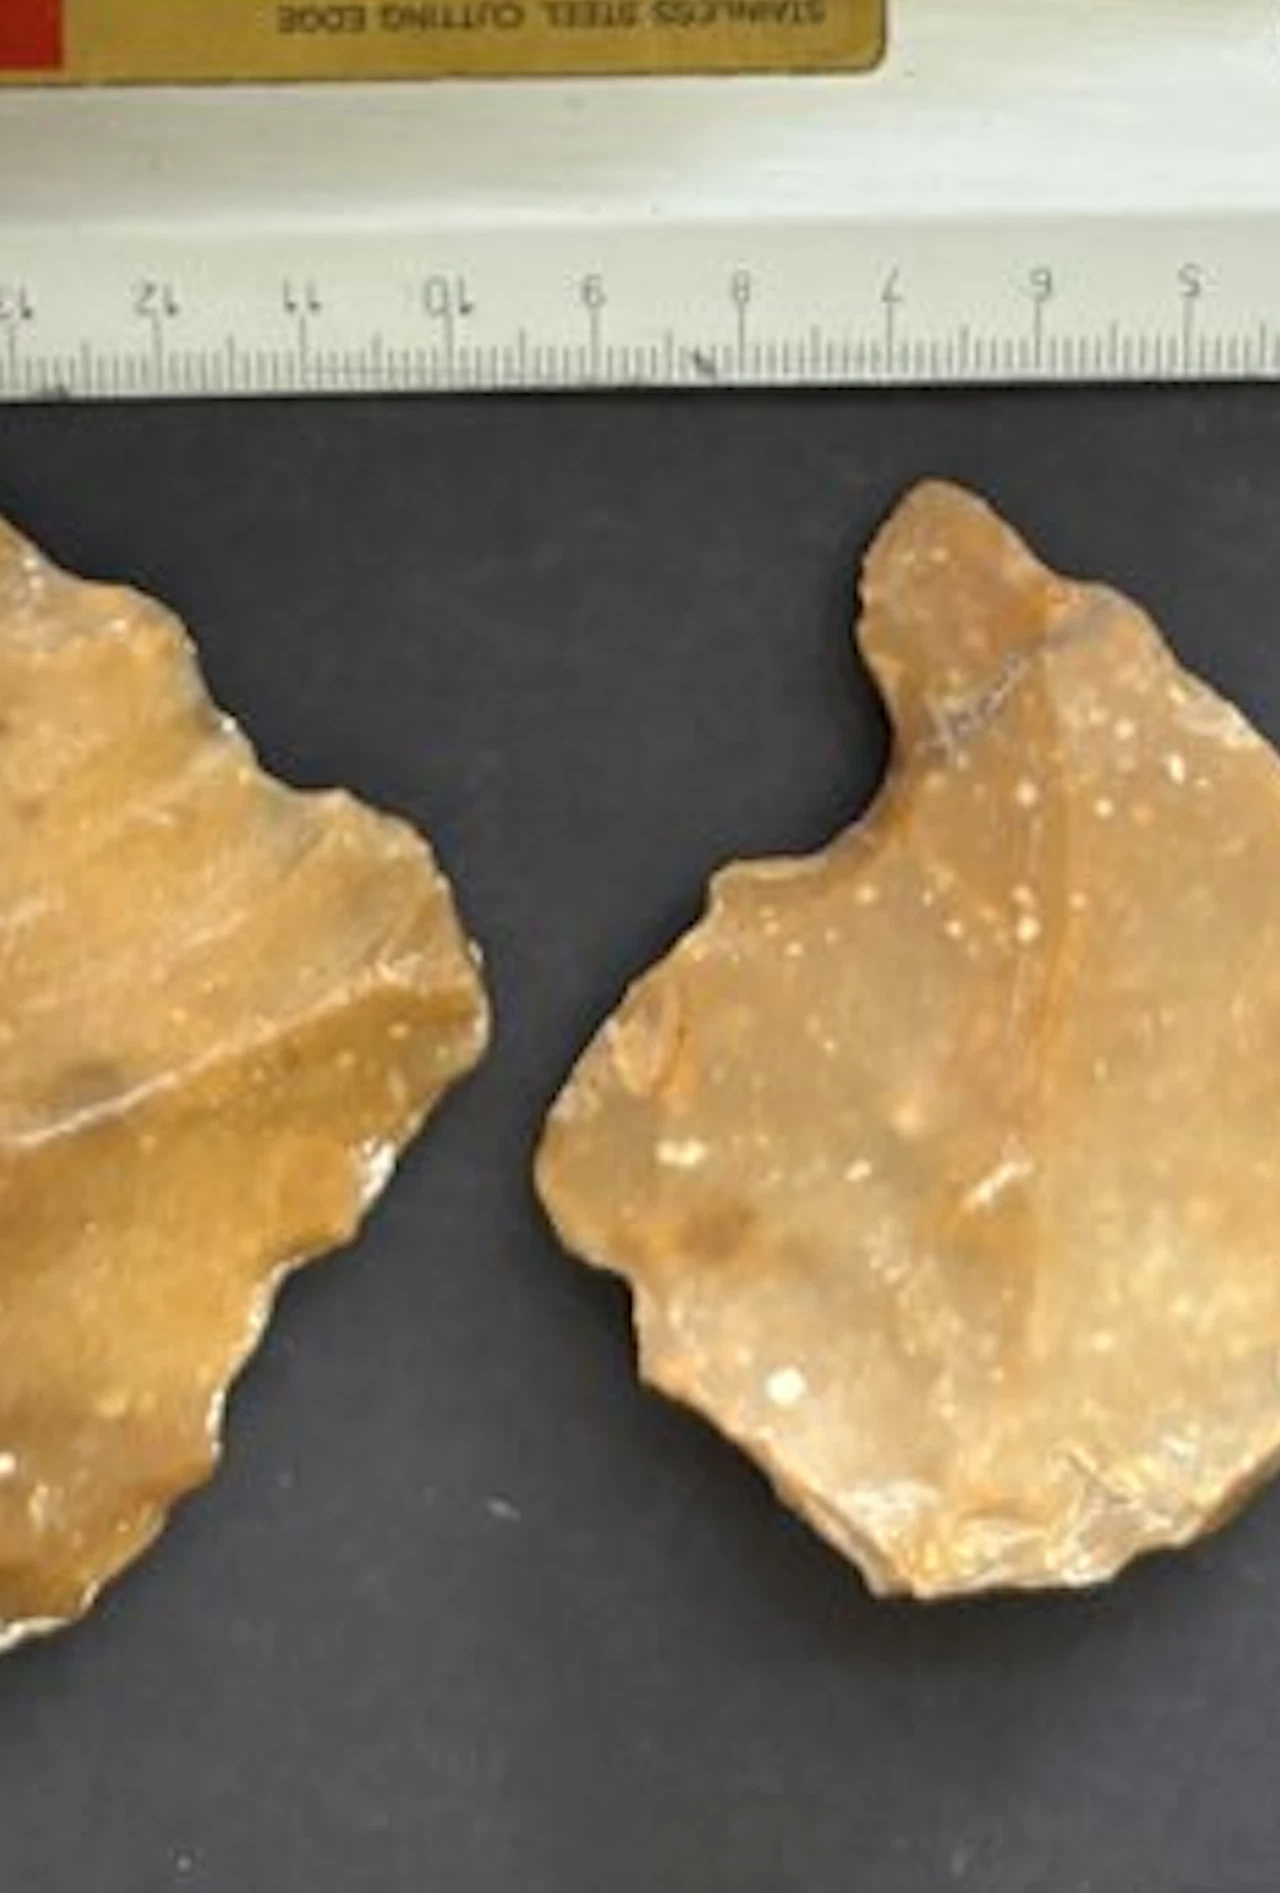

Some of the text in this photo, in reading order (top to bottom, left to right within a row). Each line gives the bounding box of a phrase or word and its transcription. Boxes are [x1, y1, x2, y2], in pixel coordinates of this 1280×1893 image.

[278, 6, 366, 34] EDGE
[381, 1, 525, 32] CUTTING
[544, 0, 638, 27] STEEL
[283, 276, 320, 313] 11
[424, 273, 473, 316] 10
[580, 273, 607, 308] 9
[730, 269, 753, 305] 8
[879, 265, 903, 304] 7
[1029, 266, 1053, 302] 6
[1176, 262, 1202, 298] 5
[133, 282, 178, 316] 12
